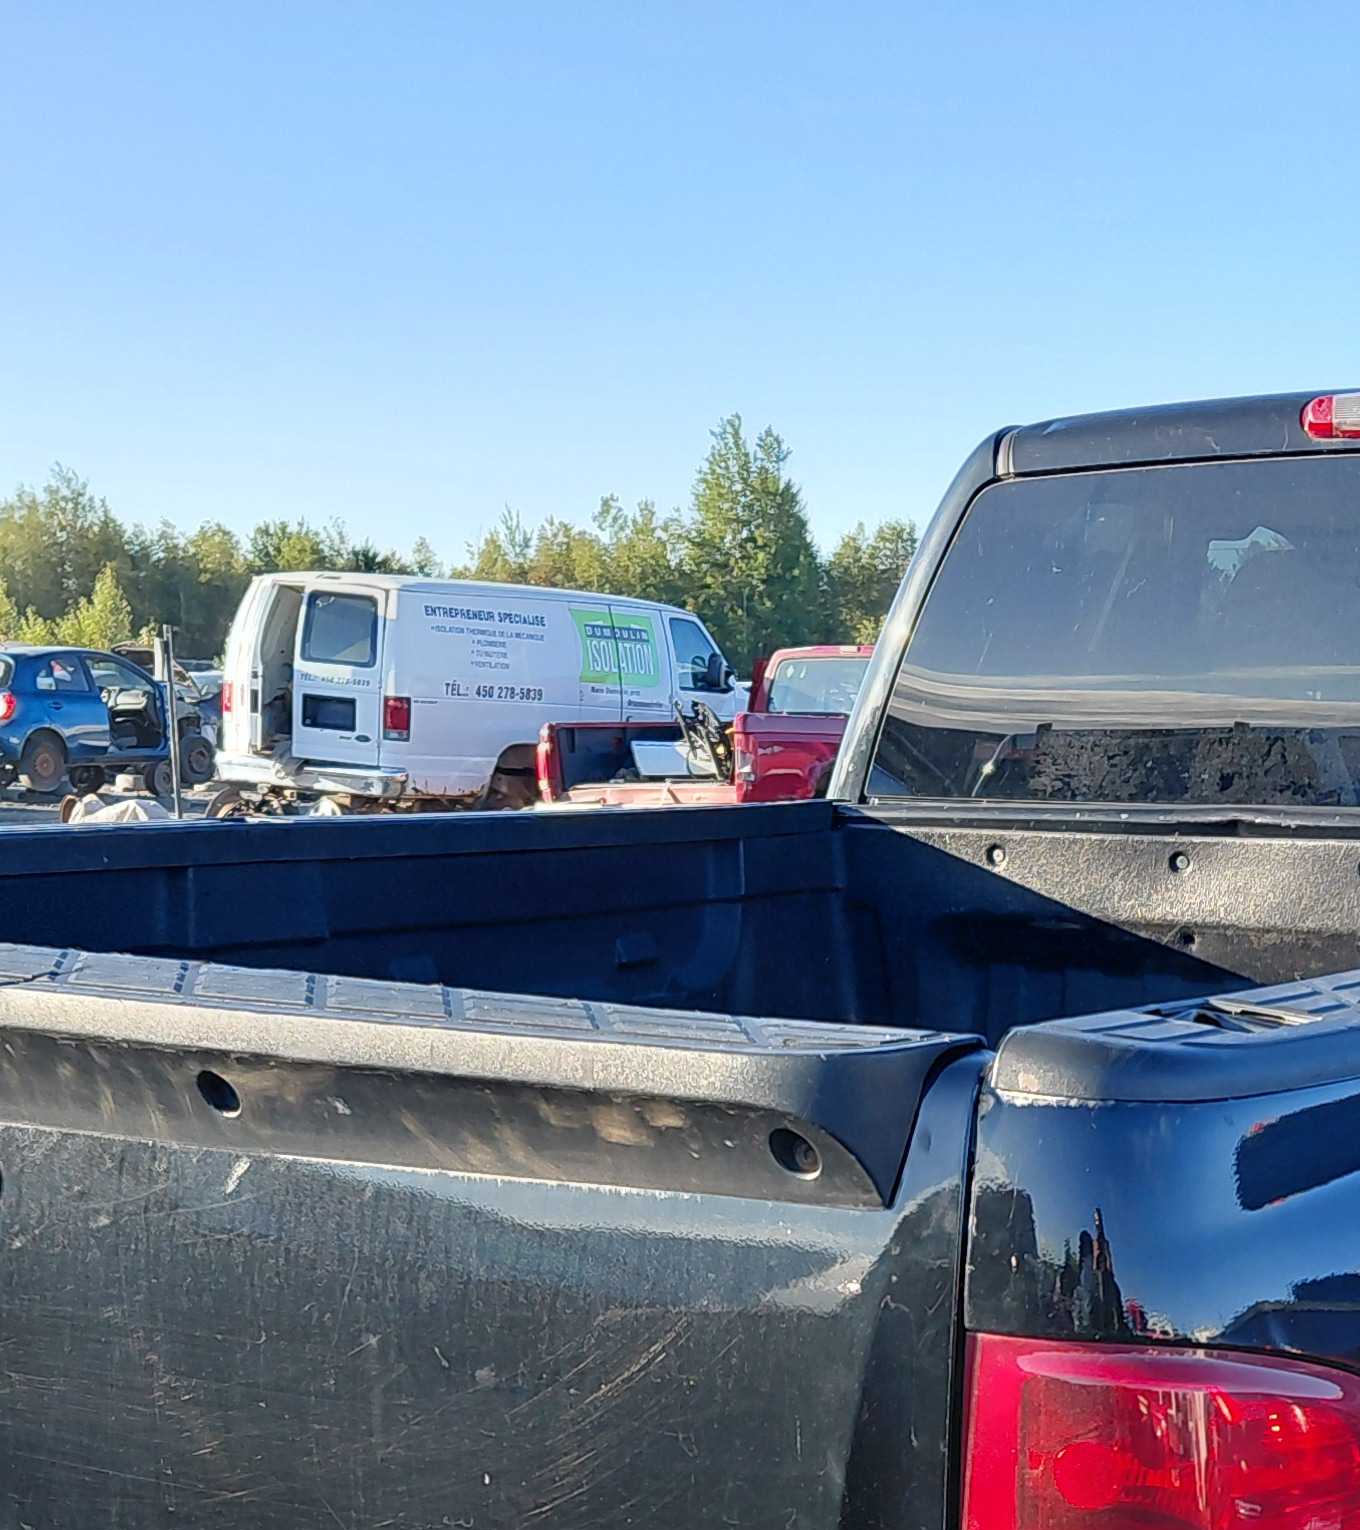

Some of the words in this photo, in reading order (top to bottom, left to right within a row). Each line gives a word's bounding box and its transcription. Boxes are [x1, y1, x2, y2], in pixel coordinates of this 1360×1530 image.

[424, 605, 495, 621] ENTREPRENEUR
[586, 640, 654, 675] ISOLATION
[476, 685, 494, 699] 450
[497, 686, 543, 701] 278-5839
